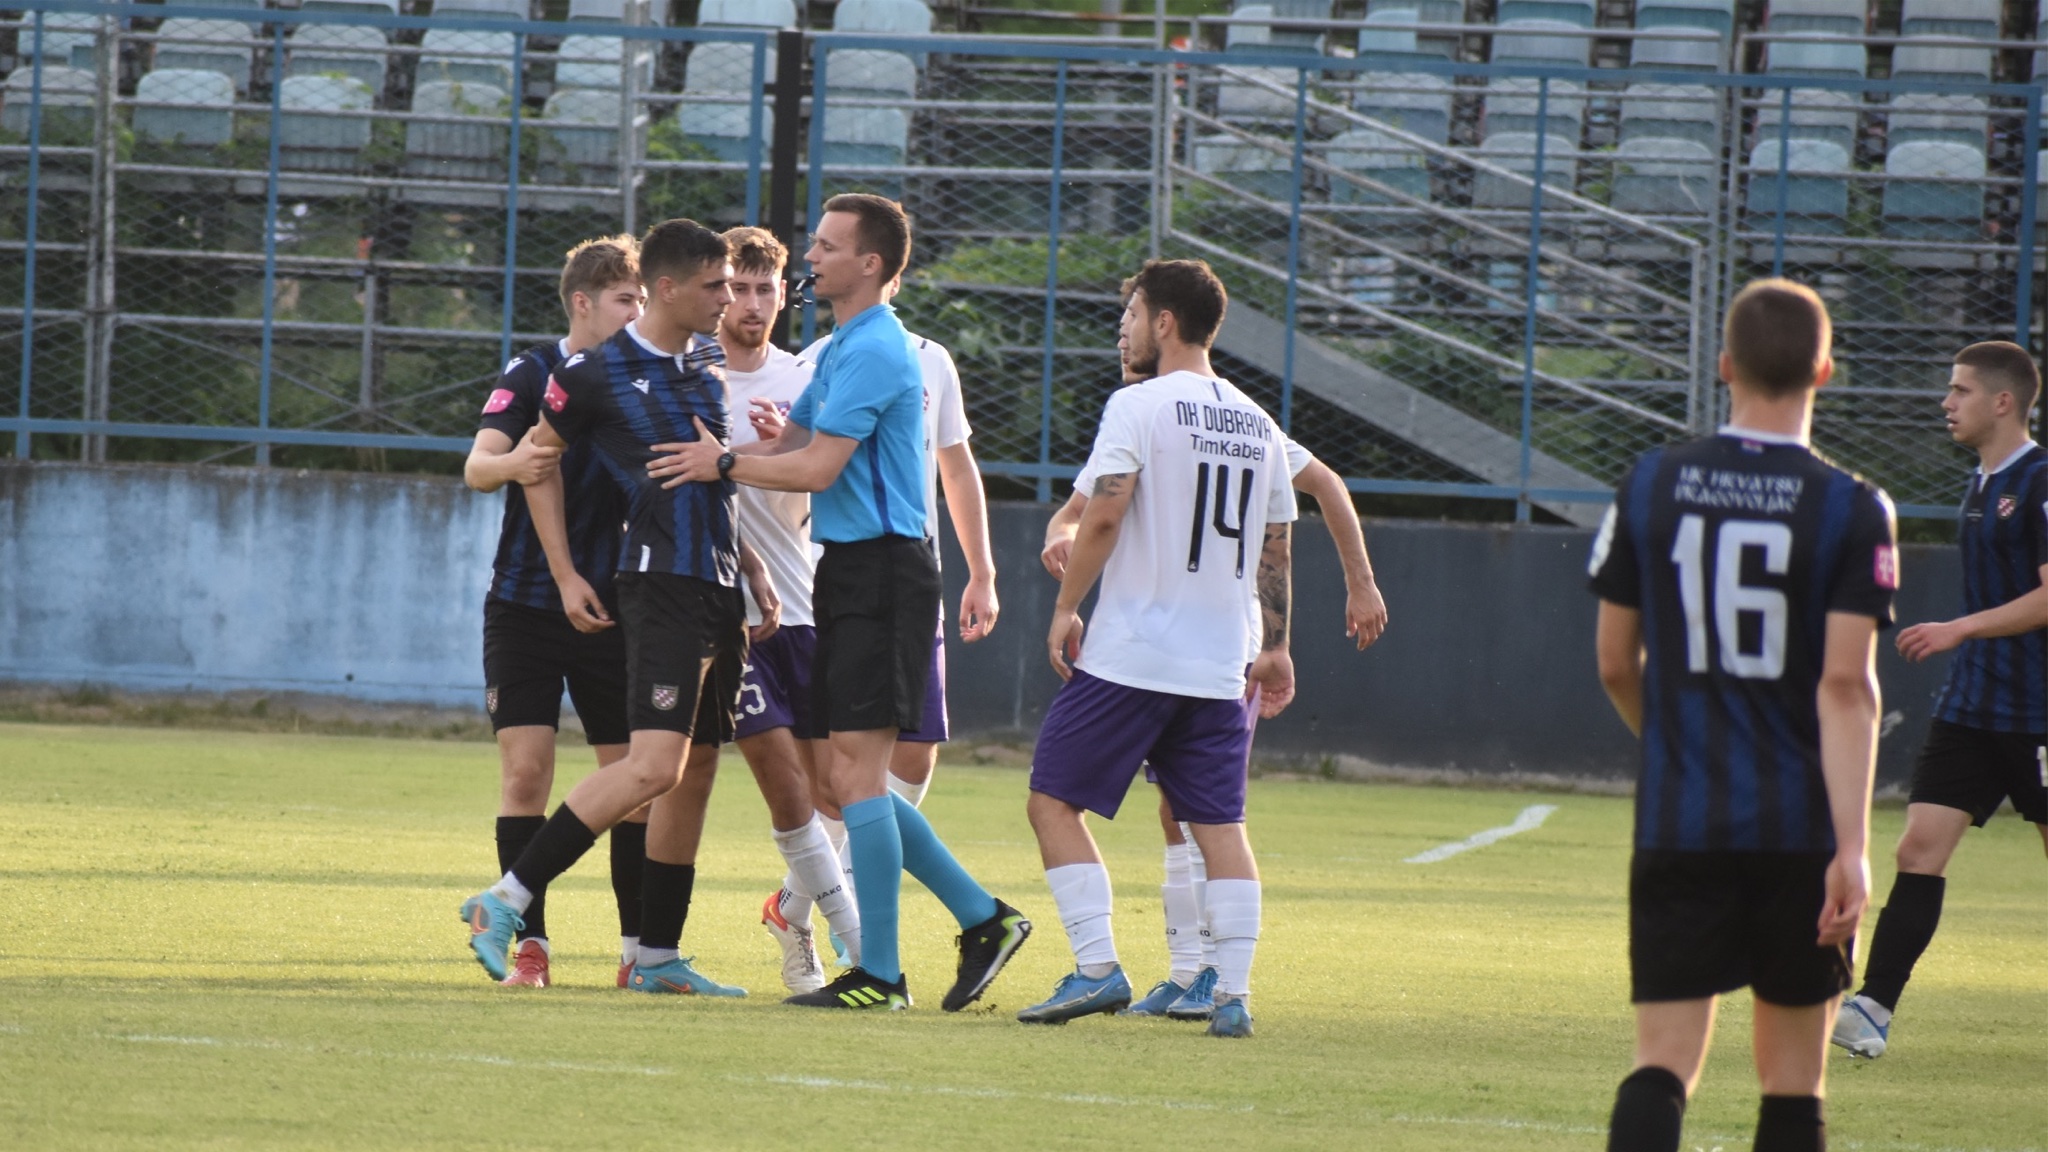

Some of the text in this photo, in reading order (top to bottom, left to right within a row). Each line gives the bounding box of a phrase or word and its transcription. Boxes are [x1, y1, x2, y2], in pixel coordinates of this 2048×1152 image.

[1176, 401, 1272, 442] NK DUBRAVA
[1190, 433, 1265, 463] TimKabel
[1187, 462, 1255, 580] 14
[1670, 513, 1793, 681] 16
[734, 664, 767, 721] 5
[816, 884, 842, 902] JAKO
